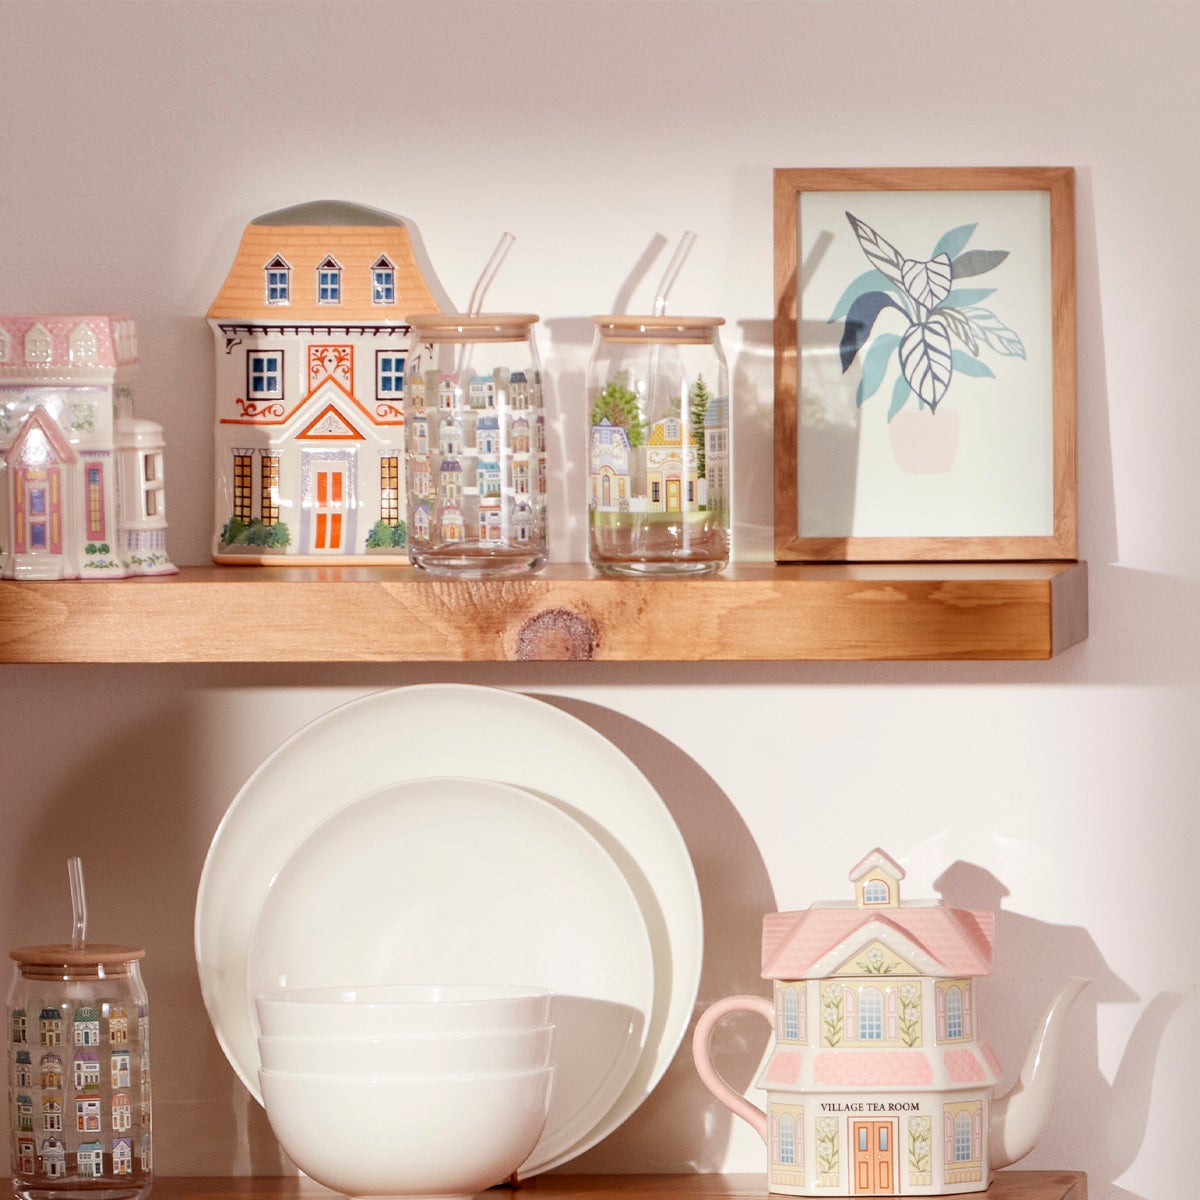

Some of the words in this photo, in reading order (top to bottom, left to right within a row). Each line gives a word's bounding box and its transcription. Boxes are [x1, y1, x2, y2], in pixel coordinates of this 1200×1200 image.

[821, 1102, 864, 1112] VILLAGE
[867, 1102, 887, 1112] TEA
[888, 1102, 920, 1112] ROOM
